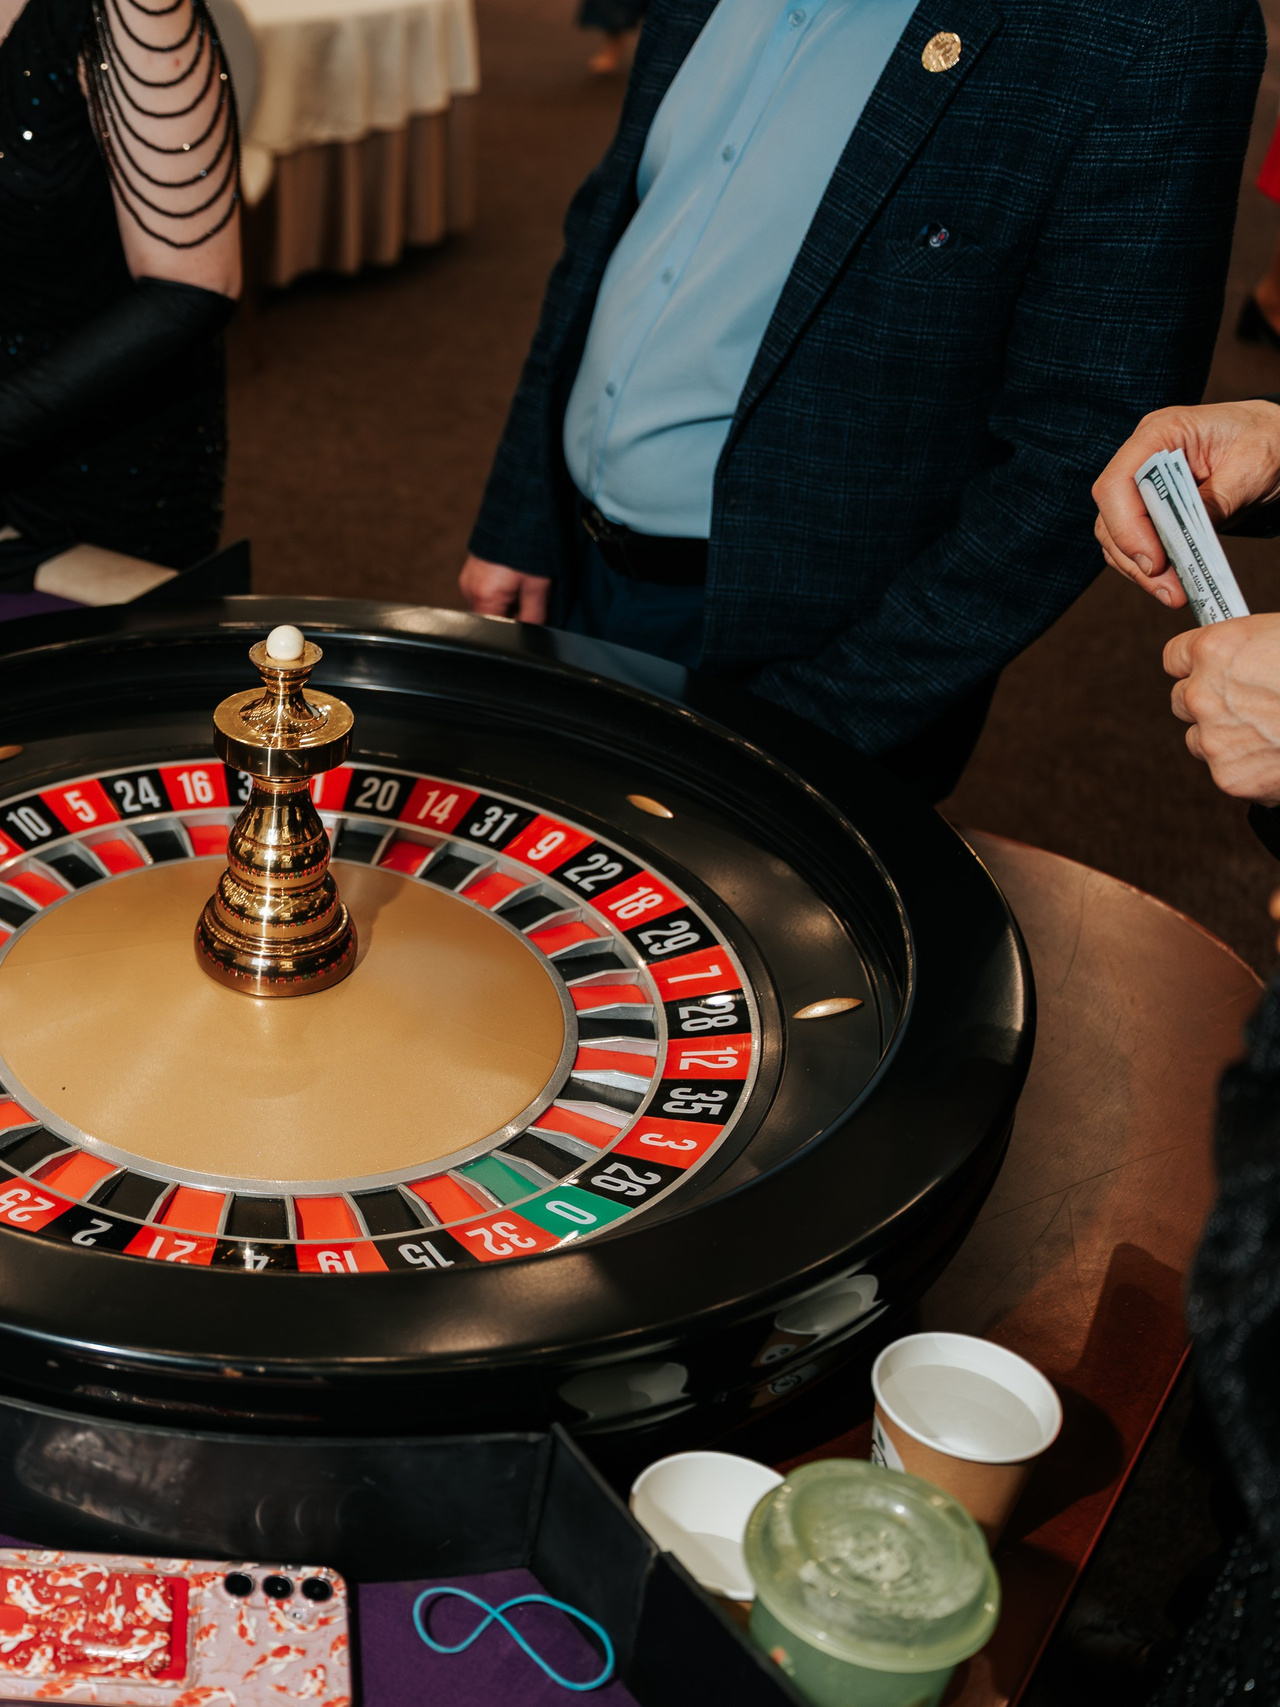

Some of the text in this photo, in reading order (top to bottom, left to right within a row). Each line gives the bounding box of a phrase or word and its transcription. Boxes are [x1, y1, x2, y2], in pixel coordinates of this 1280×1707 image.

[114, 777, 161, 813] 24
[177, 771, 214, 804] 16
[312, 773, 324, 804] 1
[354, 776, 400, 812] 20
[64, 790, 97, 823] 5
[417, 789, 460, 824] 14
[6, 807, 52, 841] 10
[469, 806, 518, 843] 31
[527, 831, 567, 861] 9
[563, 853, 623, 892] 22
[608, 886, 663, 920] 18
[637, 920, 701, 955] 29
[667, 964, 722, 984] 7
[678, 1001, 739, 1032] 28
[679, 1046, 739, 1071] 12
[662, 1087, 728, 1116] 35
[639, 1133, 697, 1151] 3
[590, 1162, 662, 1197] 26
[545, 1200, 597, 1225] 0
[71, 1218, 114, 1247] 2
[465, 1221, 537, 1256] 32
[147, 1236, 197, 1266] 21
[242, 1250, 270, 1271] 4
[316, 1250, 360, 1273] 19
[397, 1241, 456, 1270] 15
